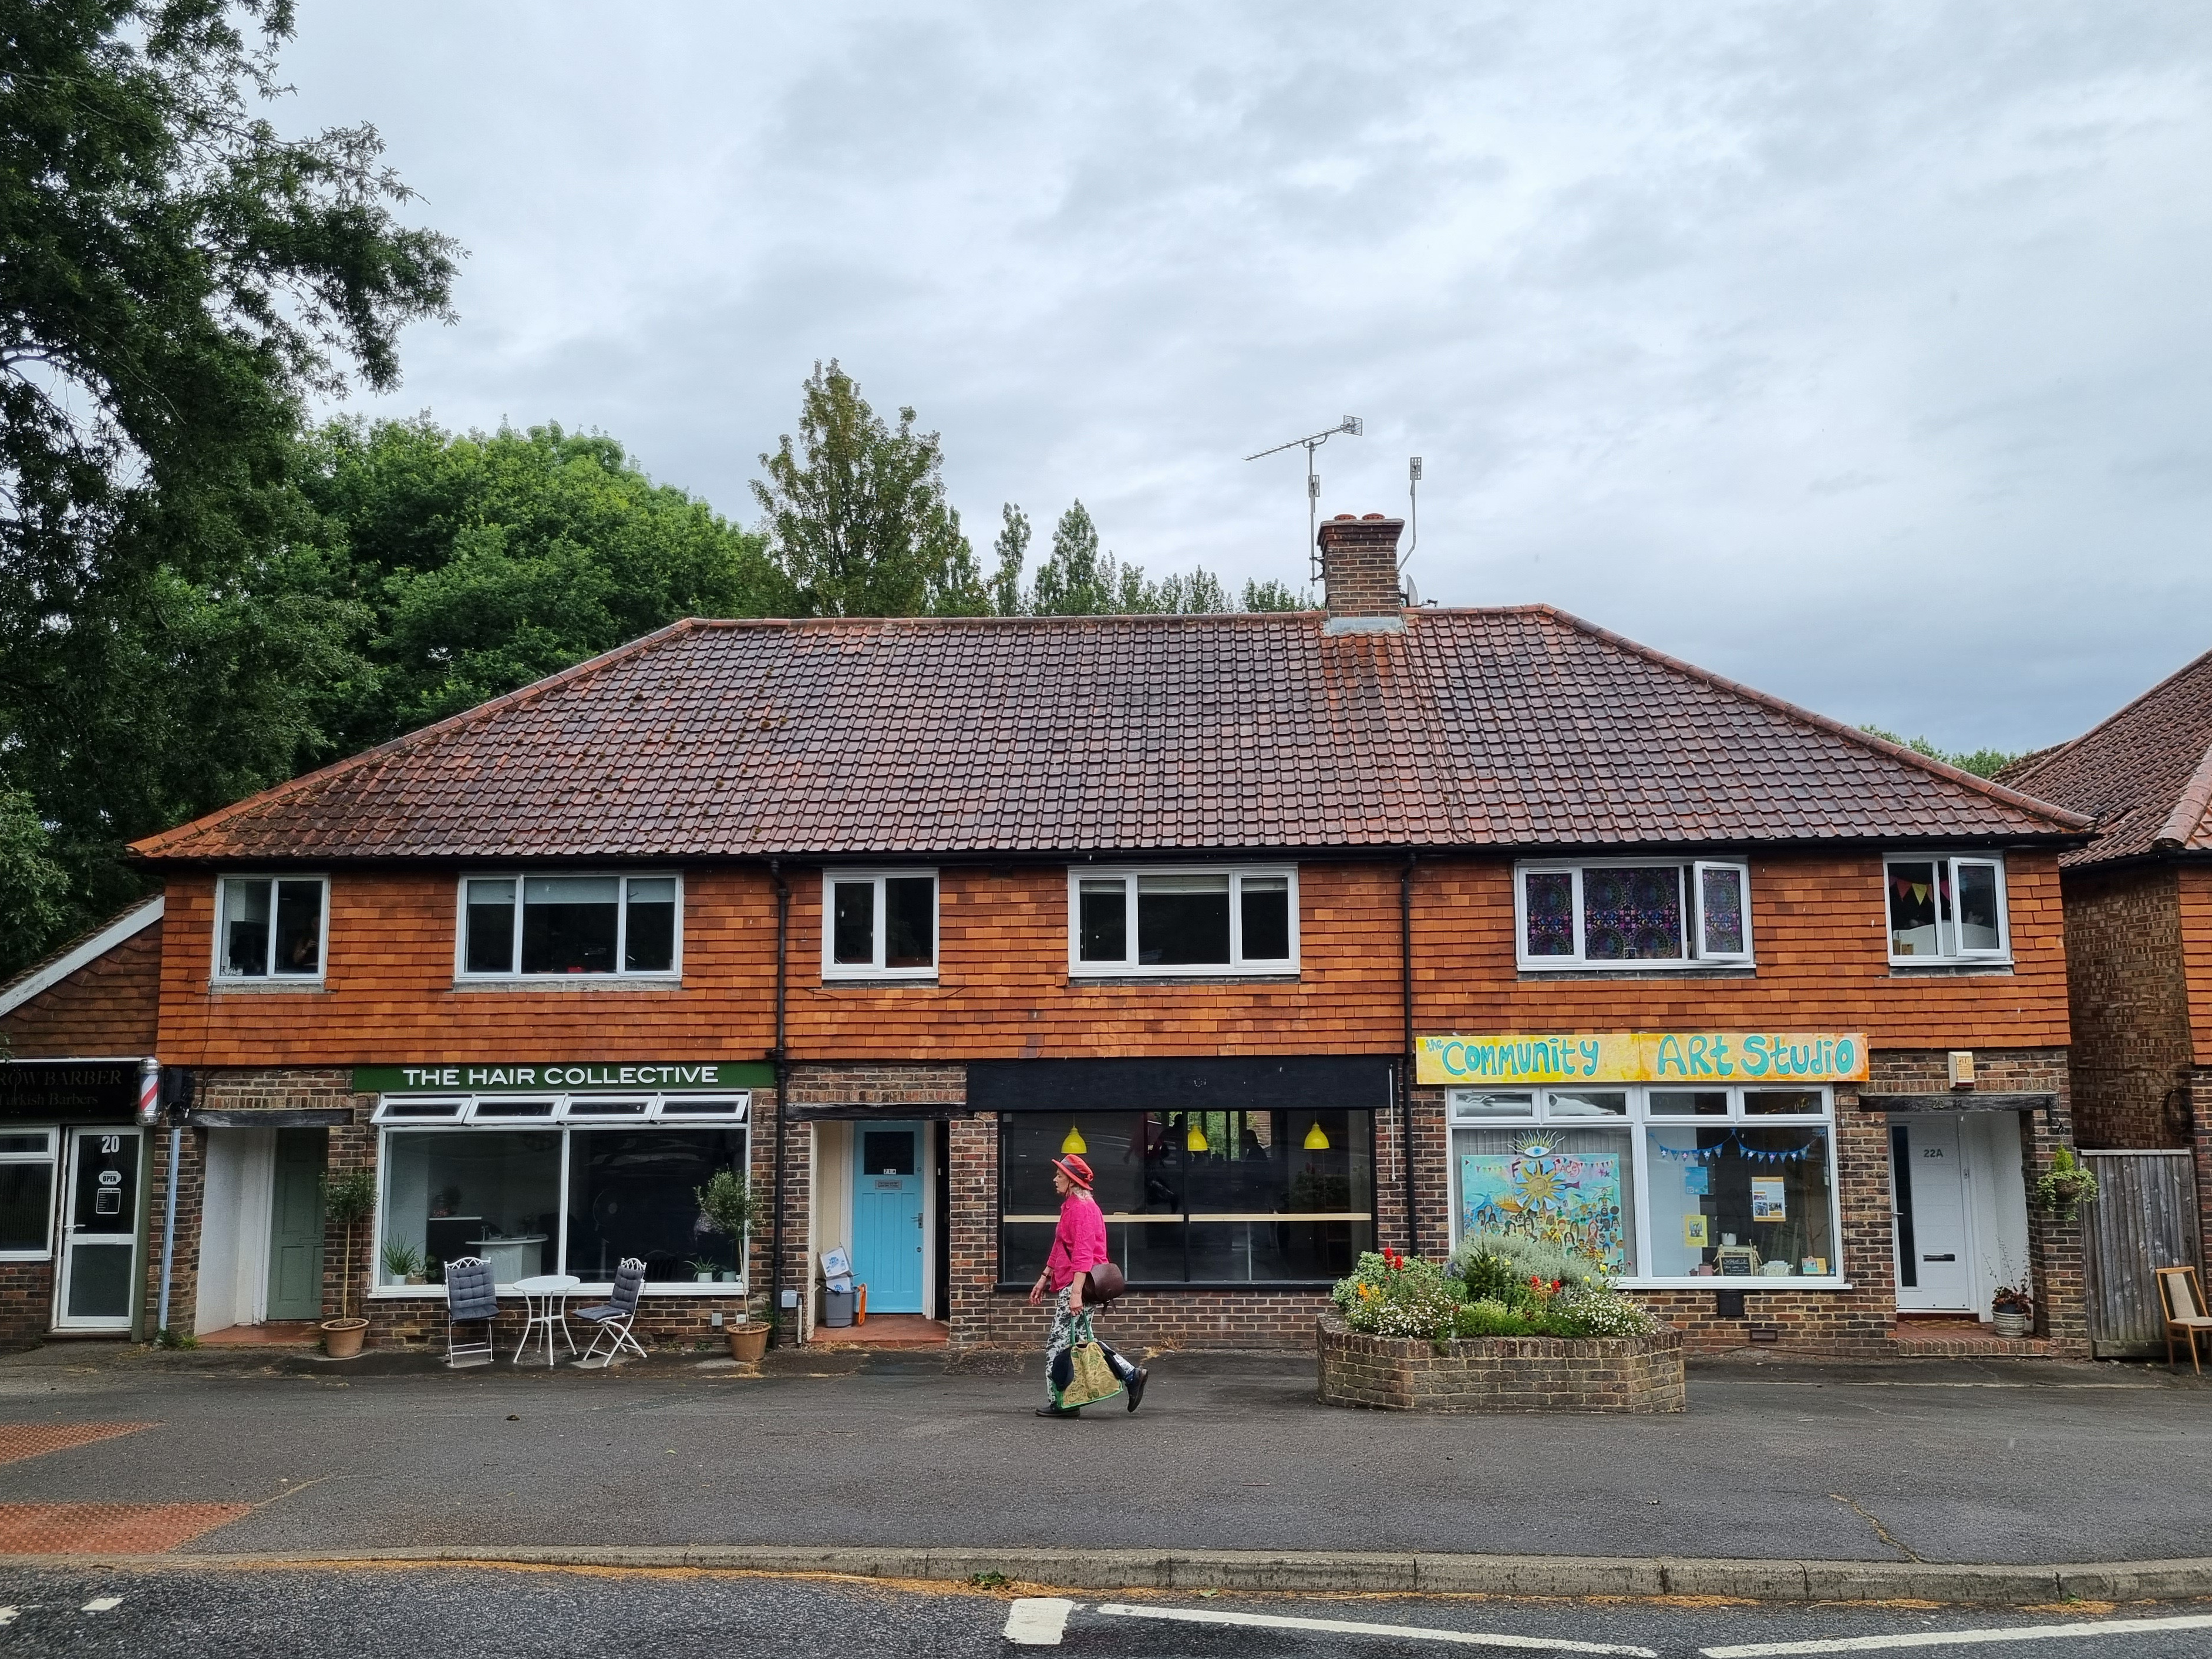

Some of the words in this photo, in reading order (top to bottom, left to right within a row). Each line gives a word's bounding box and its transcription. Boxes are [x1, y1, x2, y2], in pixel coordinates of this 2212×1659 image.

[44, 1070, 122, 1085] BARBER
[403, 1069, 460, 1085] THE
[469, 1069, 535, 1085] HAIR
[544, 1066, 718, 1084] COLLECTIVE
[49, 1093, 99, 1105] Barbers
[102, 1135, 120, 1153] 20
[1924, 1149, 1944, 1157] 22A
